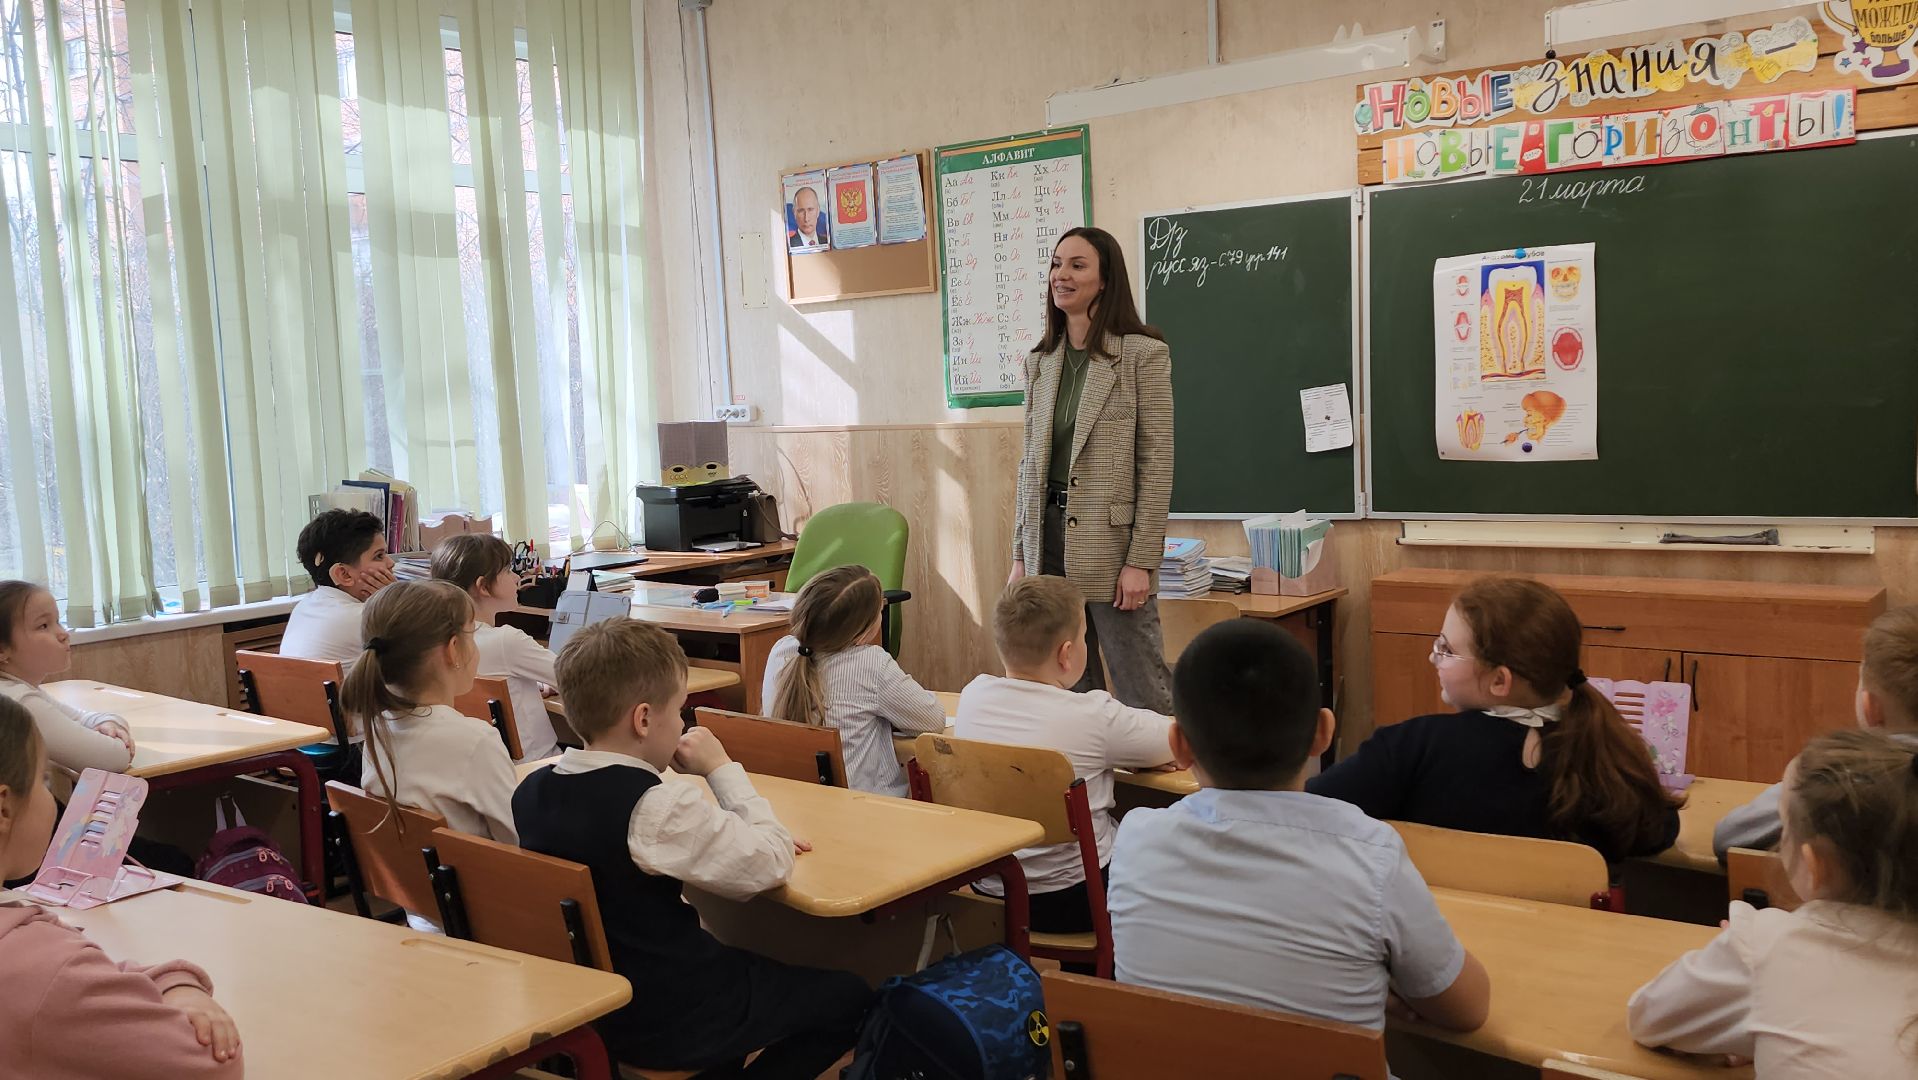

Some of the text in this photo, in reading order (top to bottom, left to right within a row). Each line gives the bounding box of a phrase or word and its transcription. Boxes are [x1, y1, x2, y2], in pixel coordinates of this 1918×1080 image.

[1369, 73, 1514, 131] НОВЫЕ
[982, 148, 1035, 165] АЛФАВИТ
[1034, 164, 1049, 175] Хх
[1519, 175, 1645, 208] 21 марта
